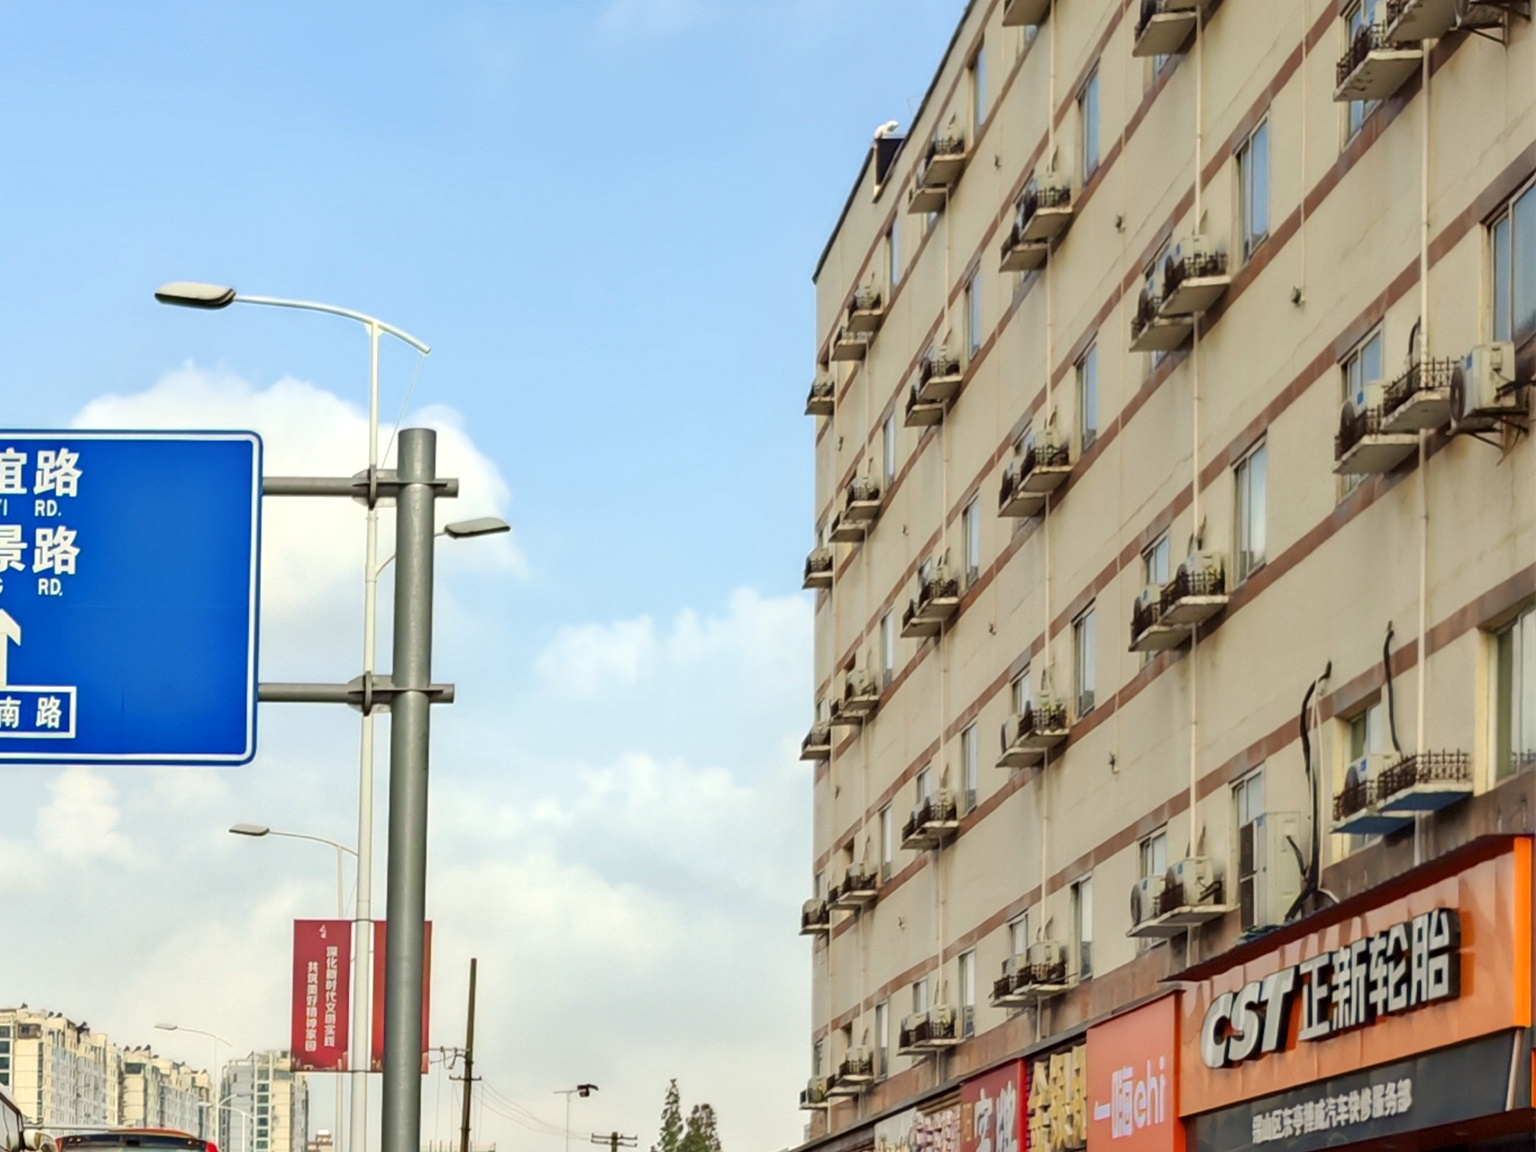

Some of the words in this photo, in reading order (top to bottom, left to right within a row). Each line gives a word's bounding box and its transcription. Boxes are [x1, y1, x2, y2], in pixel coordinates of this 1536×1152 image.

[34, 500, 62, 517] RD.
[38, 578, 64, 597] RD.
[1201, 964, 1297, 1068] CST
[1299, 908, 1458, 1042] 正新轮胎
